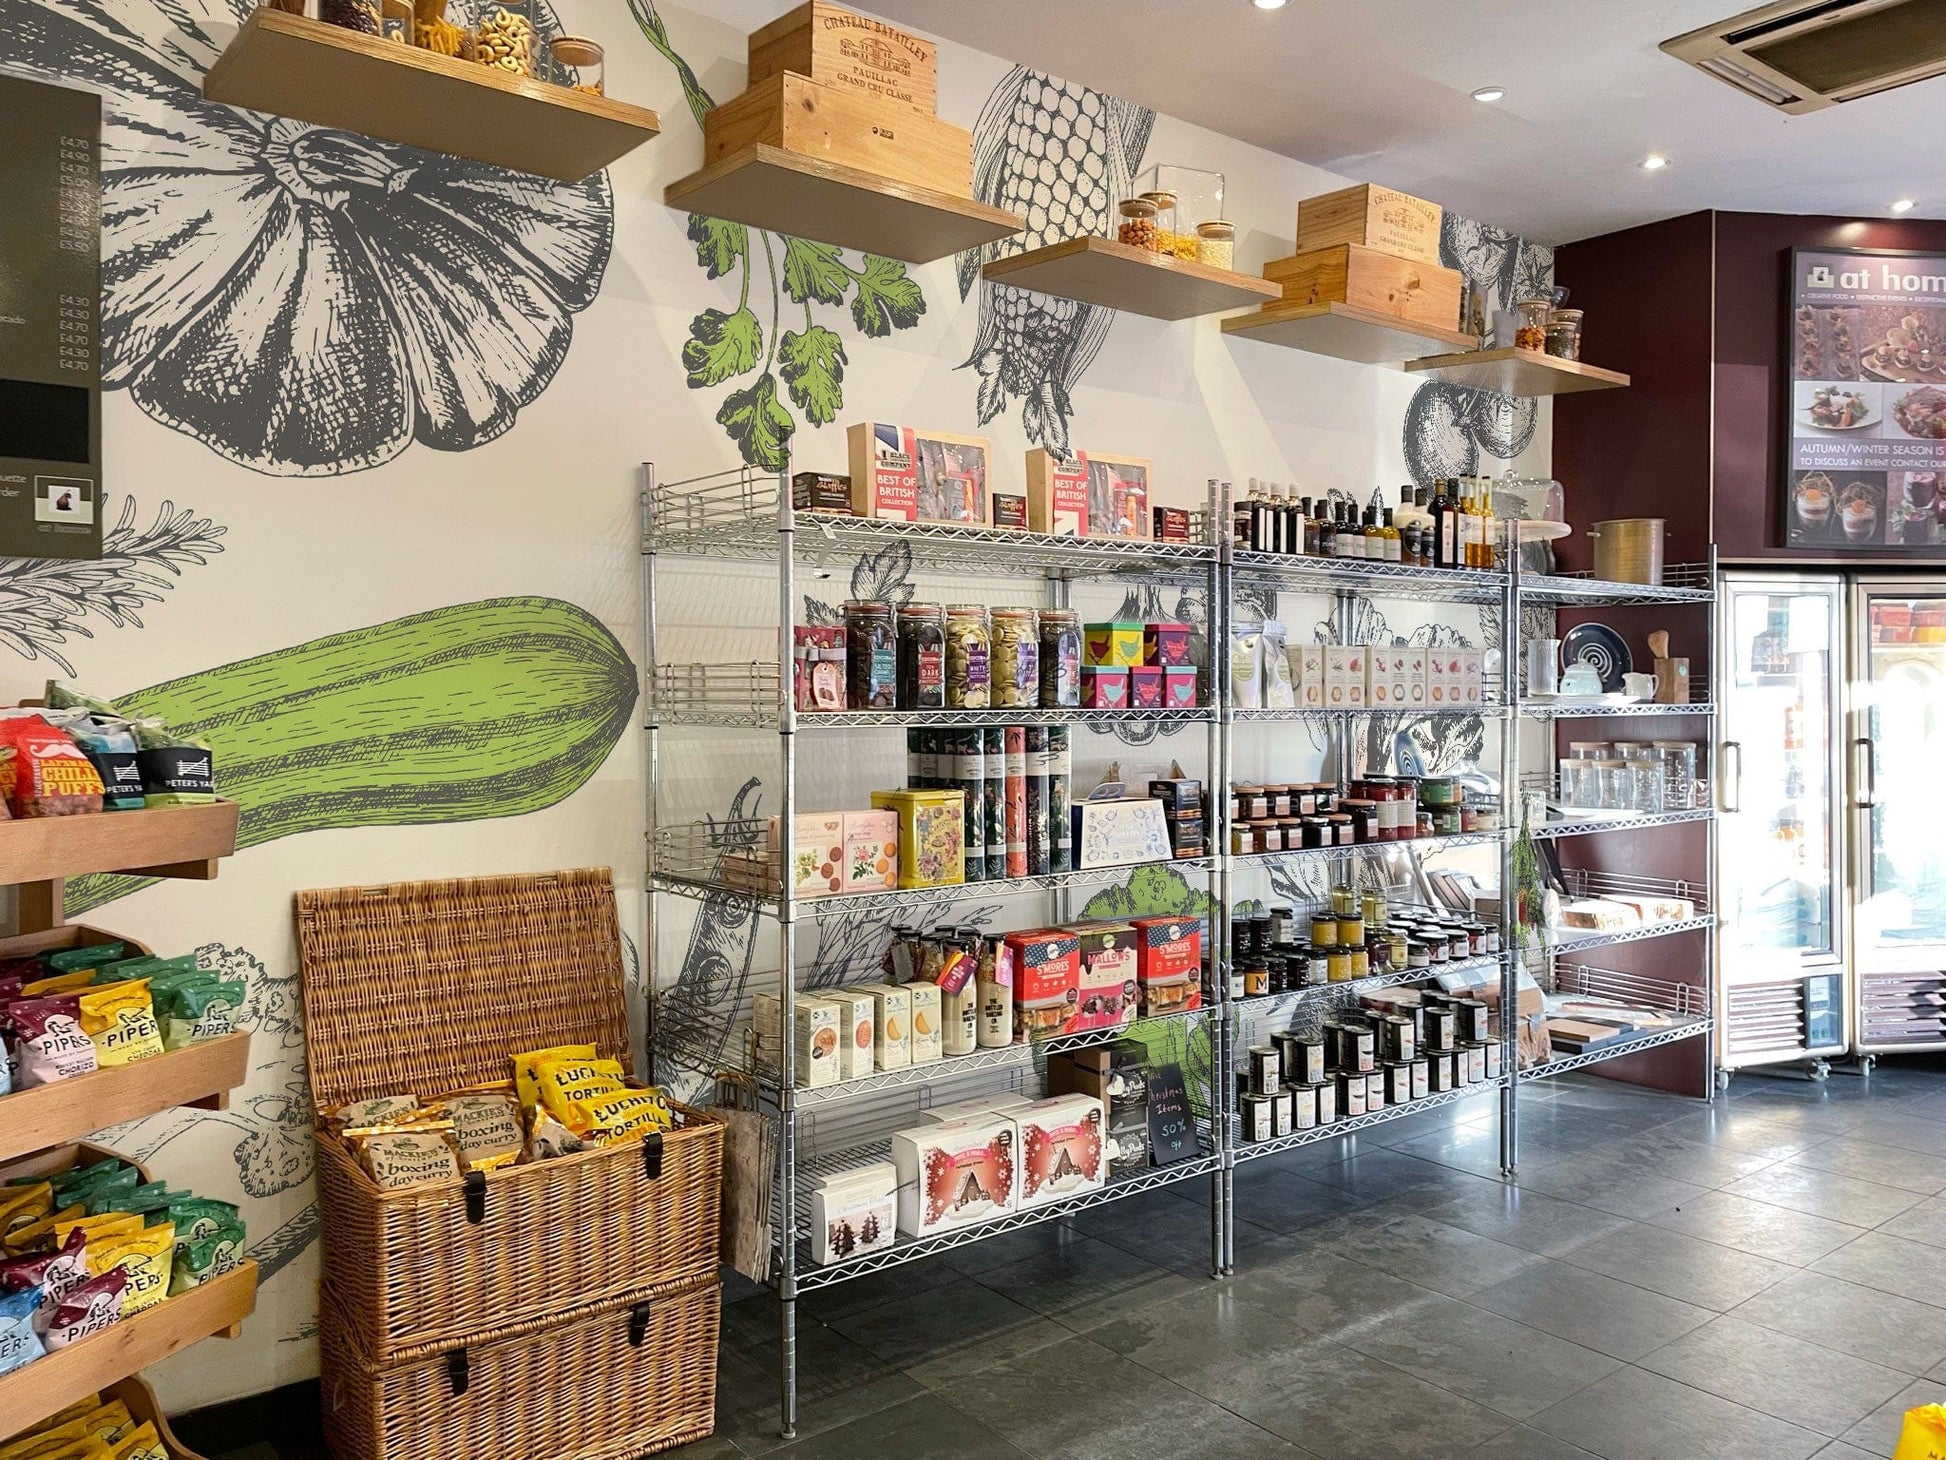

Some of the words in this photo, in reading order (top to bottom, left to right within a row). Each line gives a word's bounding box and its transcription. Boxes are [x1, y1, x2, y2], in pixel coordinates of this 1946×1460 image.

[837, 73, 865, 87] GRAND
[867, 82, 884, 93] CRU
[853, 66, 898, 86] PAUILLAC
[1840, 269, 1871, 290] at
[1800, 443, 1889, 456] AUTUMN/WINTER
[1893, 445, 1933, 456] SEASON
[1935, 446, 1944, 456] IS
[1800, 457, 1812, 466] TO
[1814, 457, 1848, 466] DISCUSS
[1850, 458, 1862, 466] AN
[1864, 459, 1889, 467] EVENT
[1891, 459, 1928, 468] CONTACT
[877, 474, 900, 485] BEST
[902, 477, 917, 487] OF
[1055, 479, 1074, 489] BEST
[1076, 481, 1088, 490] OF
[879, 486, 915, 498] BRITISH
[1056, 490, 1086, 501] BRITISH
[921, 669, 939, 677] DARK
[42, 781, 106, 798] PUFFS
[165, 780, 197, 788] PETER'S
[1160, 942, 1191, 955] S'MORES
[1087, 952, 1130, 965] MALLOWS
[1036, 961, 1070, 975] S'MORES
[58, 1061, 94, 1075] CHORIZO
[1155, 1103, 1182, 1114] Items
[458, 1121, 514, 1140] boxing
[1161, 1117, 1187, 1137] 50%
[460, 1139, 482, 1152] day
[483, 1132, 518, 1147] curry
[388, 1159, 450, 1175] boxing
[389, 1175, 414, 1188] day
[415, 1168, 453, 1183] curry
[67, 1307, 122, 1342] PIPERS
